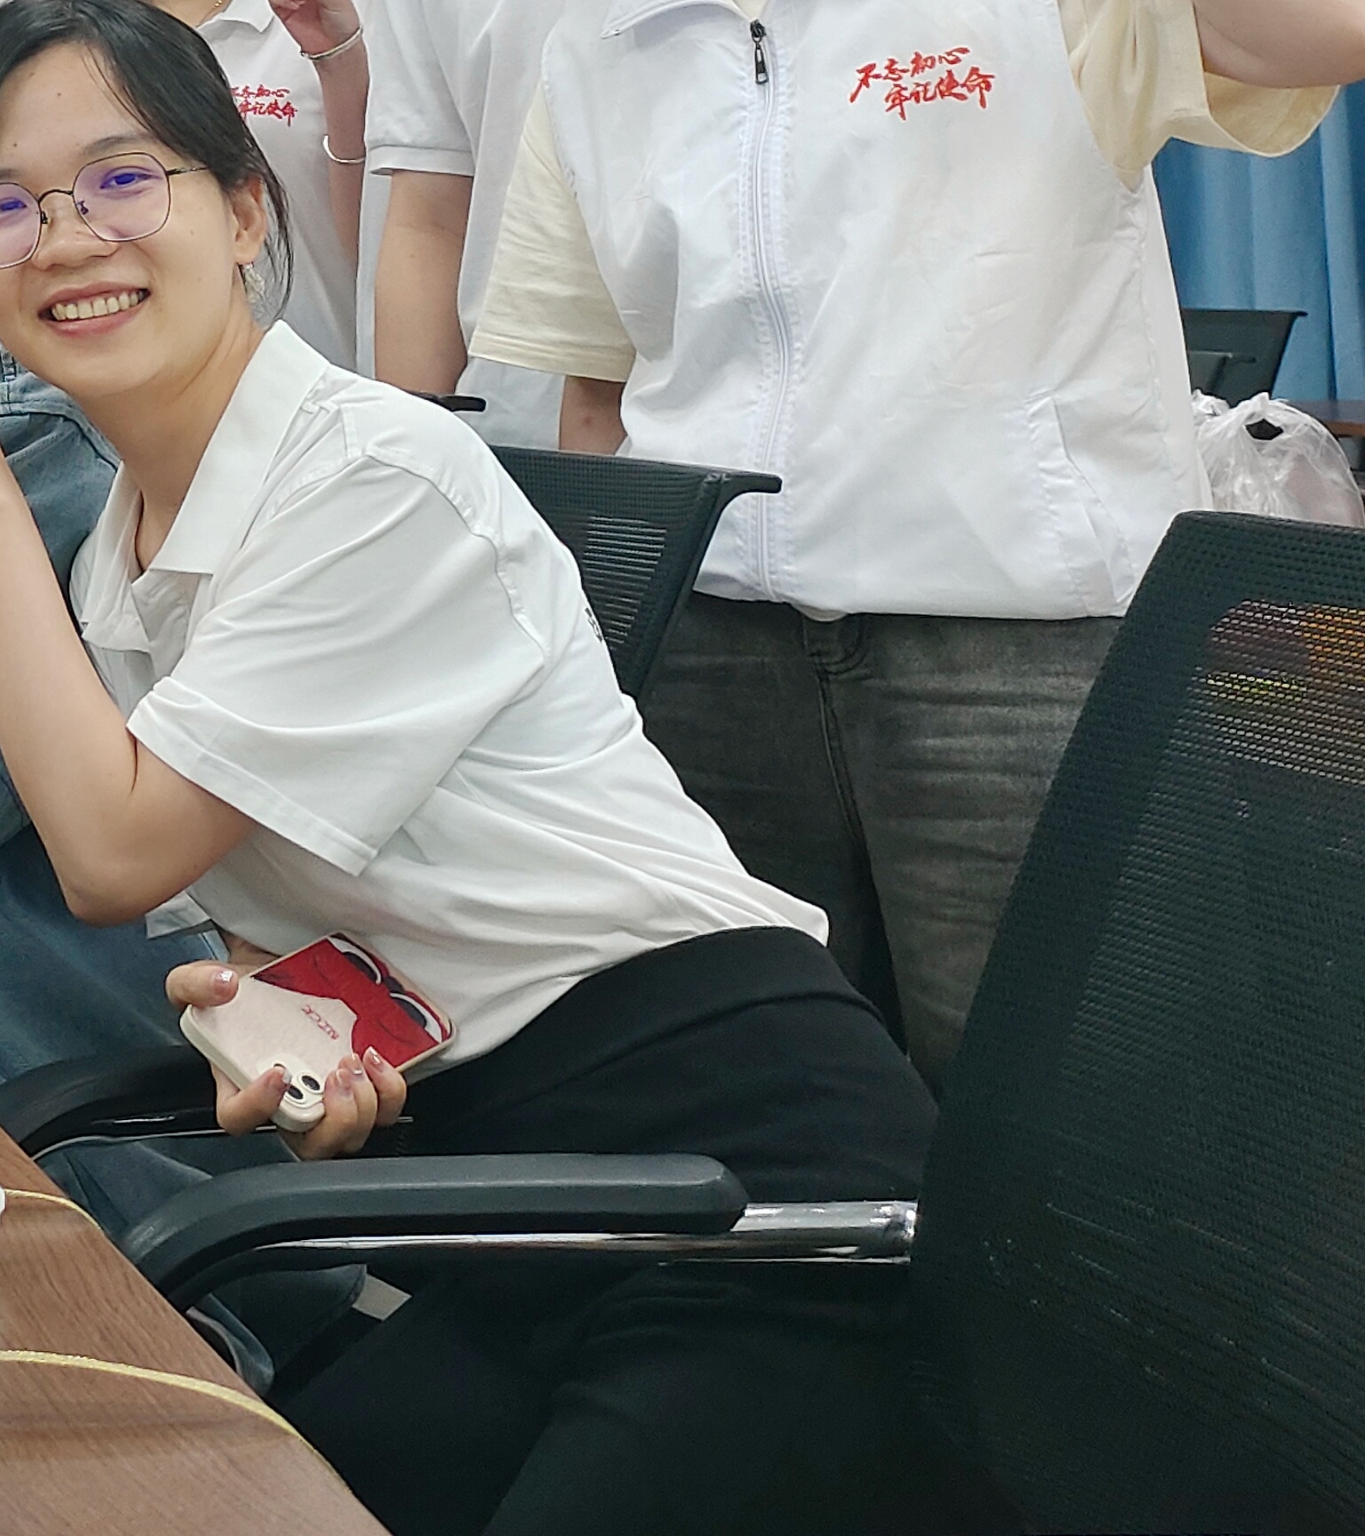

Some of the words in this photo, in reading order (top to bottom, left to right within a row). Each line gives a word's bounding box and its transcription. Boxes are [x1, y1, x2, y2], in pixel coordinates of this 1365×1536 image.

[849, 46, 971, 104] 不忘初心
[884, 66, 996, 121] 牢记使命
